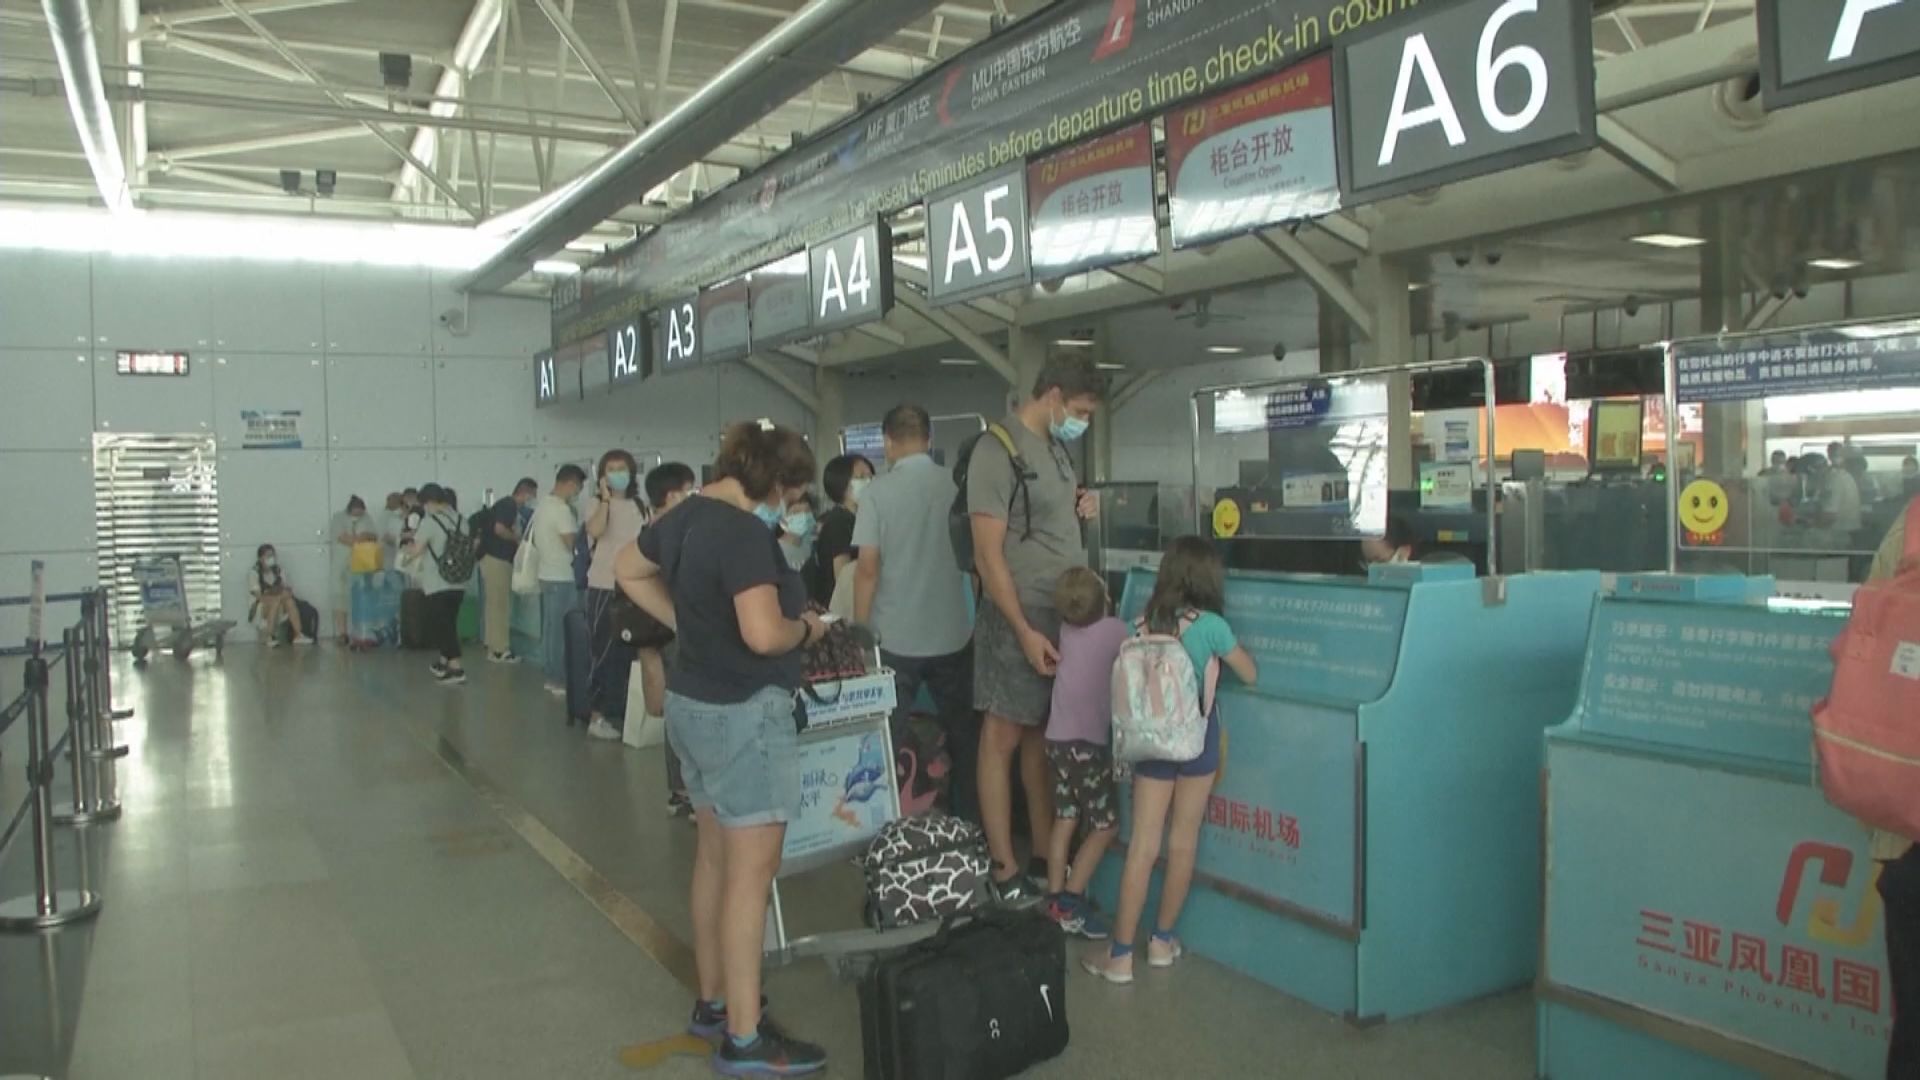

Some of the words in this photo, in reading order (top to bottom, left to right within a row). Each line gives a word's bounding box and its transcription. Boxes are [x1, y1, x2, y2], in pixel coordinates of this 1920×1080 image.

[910, 151, 986, 199] 45minutes
[989, 131, 1042, 168] before
[1048, 87, 1143, 146] departure
[1148, 14, 1319, 107] time,check-in
[971, 88, 999, 110] CHINA
[1002, 62, 1047, 93] EASTERN
[1377, 0, 1549, 167] A6
[1210, 123, 1294, 178] 柜台开放
[1258, 162, 1282, 183] Open
[1061, 178, 1124, 219] 柜台开放
[944, 184, 1015, 285] A5
[820, 236, 871, 318] A4
[614, 326, 637, 378] A2
[667, 303, 695, 361] A3
[540, 358, 554, 398] A1
[1207, 794, 1300, 848] 国际机场
[1636, 909, 1881, 1016] 三亚凤凰国
[1637, 953, 1708, 987] Sanya
[1723, 978, 1831, 1022] Phoenix
